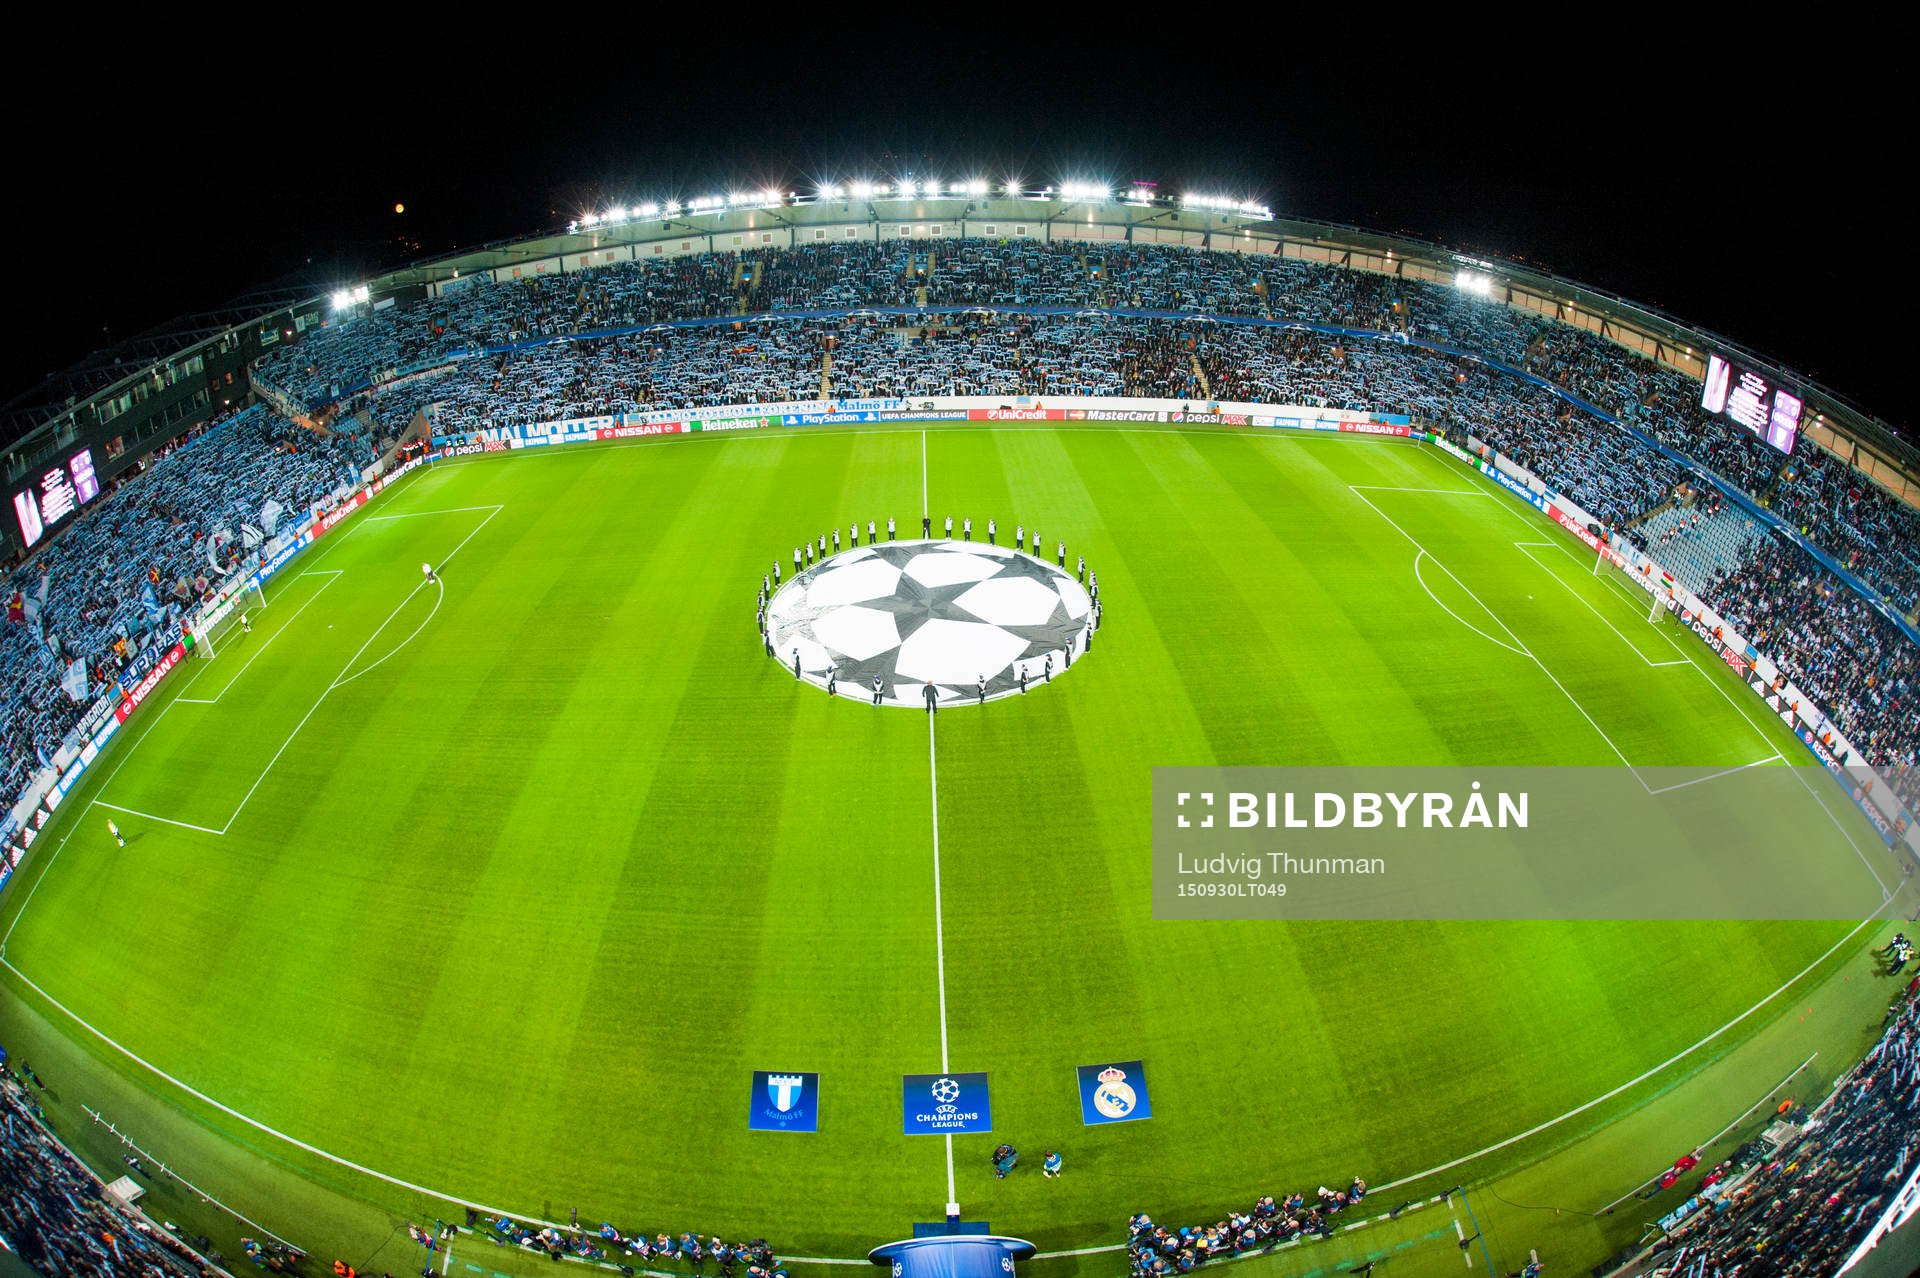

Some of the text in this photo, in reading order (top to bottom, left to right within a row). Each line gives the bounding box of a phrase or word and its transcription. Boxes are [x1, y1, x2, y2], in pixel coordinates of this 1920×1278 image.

[803, 413, 859, 425] PlayStation
[882, 410, 966, 420] UEFA CHAMPIONS LEAGUE
[999, 410, 1047, 420] UniCredit
[1088, 410, 1155, 422] MasterCard
[1187, 413, 1219, 424] pepsi
[1221, 413, 1247, 426] MAX
[615, 423, 662, 438] NISSAN
[702, 417, 758, 431] Heineken
[1355, 423, 1394, 435] NISSAN
[456, 443, 483, 456] pepsi
[484, 440, 507, 453] MAX
[383, 456, 422, 488] MasterCard
[1497, 473, 1532, 502] PlayStation
[1565, 519, 1598, 549] UniCredit
[260, 546, 296, 579] PlayStation
[1691, 621, 1748, 678] pepsi MAX
[131, 658, 173, 706] NISSAN
[1812, 741, 1843, 775] RESPECT
[916, 1112, 978, 1122] CHAMPIONS
